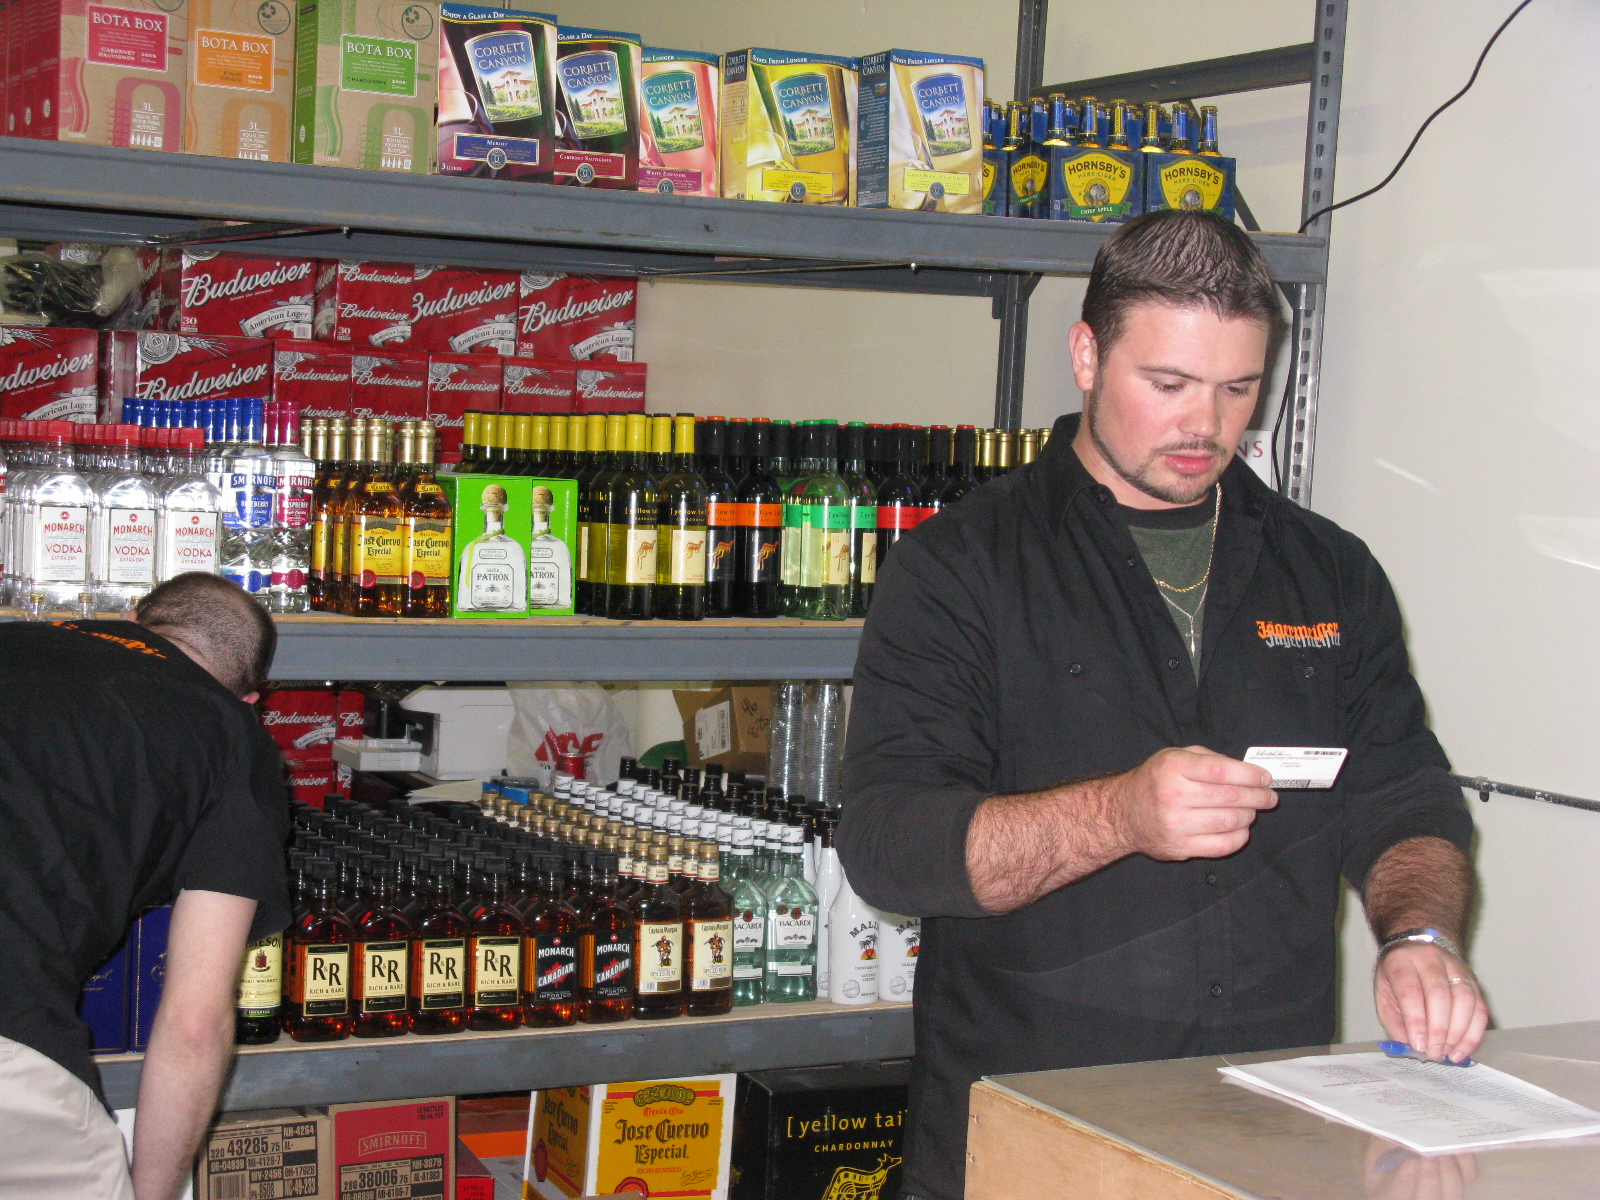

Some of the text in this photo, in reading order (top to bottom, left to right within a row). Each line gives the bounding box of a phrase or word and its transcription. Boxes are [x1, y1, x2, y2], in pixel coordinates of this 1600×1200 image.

[93, 12, 164, 32] BOTA BOX
[442, 9, 461, 19] ENJOY
[468, 12, 487, 20] GLASS
[493, 11, 505, 19] DAY
[101, 46, 136, 56] CABERNET
[201, 36, 269, 55] BOTA BOX
[346, 41, 413, 60] BOTA BOX
[474, 41, 525, 58] CORBETT
[478, 54, 527, 70] CANYON
[862, 53, 887, 67] CORBETT
[563, 61, 611, 76] CORBETT
[862, 63, 886, 76] CANYON
[567, 73, 613, 88] CANYON
[646, 79, 691, 95] CORBETT
[779, 82, 823, 98] CORBETT
[918, 82, 959, 98] CORBETT
[650, 91, 692, 106] CANYON
[783, 94, 824, 109] CANYON
[921, 95, 960, 109] CANYON
[142, 102, 153, 111] 3L
[249, 122, 260, 131] 3L
[393, 127, 404, 136] 3L
[486, 139, 508, 147] MERLOT
[1013, 161, 1045, 175] HORNSBY'S
[1068, 161, 1127, 179] HORNSBY'S
[1164, 168, 1220, 185] HORNSBY'S
[342, 265, 412, 284] Budweiser
[181, 262, 312, 309] Budweiser
[339, 303, 409, 320] Budweiser
[519, 289, 634, 335] Budweiser
[182, 317, 198, 325] 30
[249, 310, 309, 332] American Lager
[457, 327, 513, 350] American Lager
[520, 342, 533, 350] 30
[578, 335, 630, 357] American Lager
[279, 366, 348, 382] Budweiser
[356, 371, 424, 388] Budweiser
[136, 364, 268, 400] Budweiser
[432, 377, 499, 394] Budweiser
[506, 380, 572, 396] Budweiser
[580, 384, 644, 399] Budweiser
[70, 401, 93, 410] Lager
[233, 475, 276, 487] SMRNOFF
[44, 523, 85, 534] MONARCH
[113, 526, 153, 535] MONARCH
[175, 527, 215, 538] MONARCH
[45, 544, 83, 553] VODKA
[376, 536, 401, 547] Cuervo
[425, 537, 450, 548] Cuervo
[114, 546, 150, 556] VODKA
[176, 548, 212, 557] VODKA
[262, 710, 332, 726] Budweiser
[538, 947, 574, 958] MONARCH
[597, 944, 630, 955] MONARCH
[538, 963, 574, 987] CANADIAN
[597, 959, 630, 982] CANADIAN
[424, 1105, 444, 1113] BOTTLES
[668, 1107, 684, 1116] Oro
[284, 1125, 314, 1136] NH-4264
[613, 1118, 710, 1145] Jose Cuervo
[799, 1110, 908, 1138] yellow tai
[211, 1136, 280, 1159] 320 43285 75
[362, 1134, 422, 1151] SMIRNOFF
[815, 1140, 894, 1153] CHARDONNAY
[359, 1169, 398, 1188] 38006
[400, 1175, 408, 1184] 75
